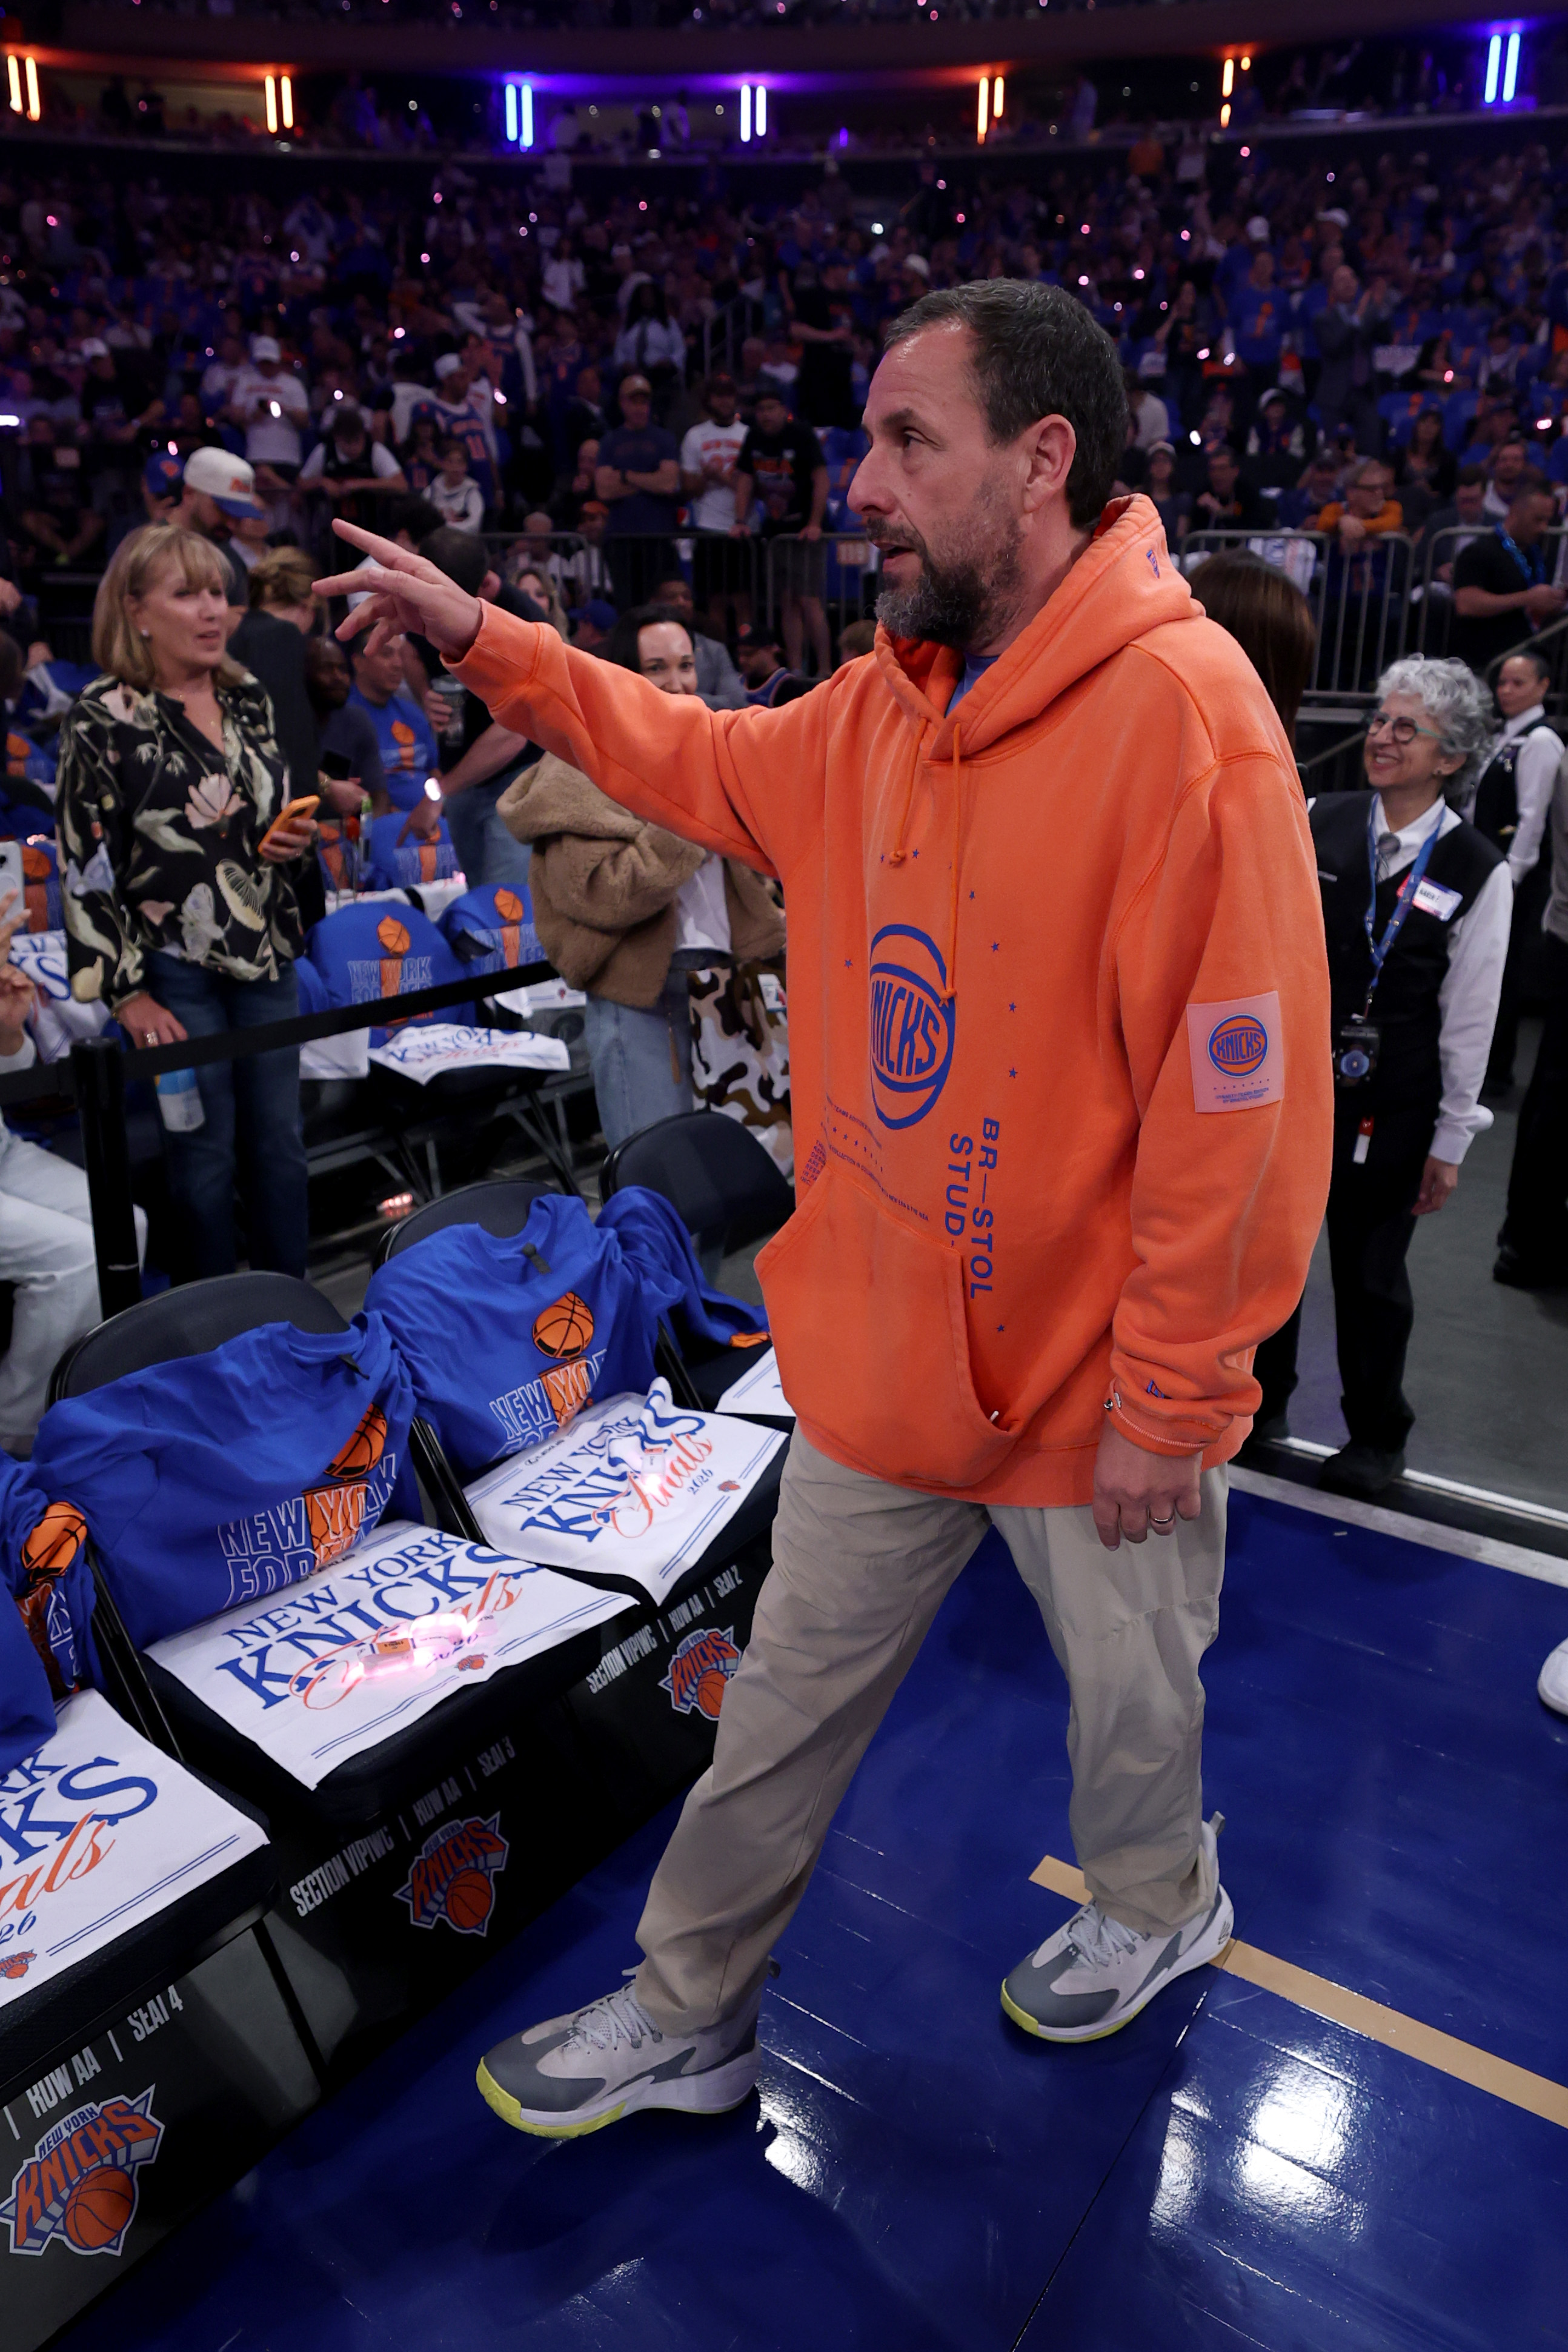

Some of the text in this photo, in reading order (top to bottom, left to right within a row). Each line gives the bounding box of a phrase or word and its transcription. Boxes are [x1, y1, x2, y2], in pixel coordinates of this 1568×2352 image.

[872, 980, 940, 1076] NICKS
[1216, 1032, 1262, 1060] KNICKS
[489, 1378, 552, 1440] NEW
[217, 1496, 305, 1558] NEW
[500, 1461, 582, 1511] NEW
[686, 1467, 714, 1495] 2026
[216, 1543, 542, 1710] KNICKS
[221, 1584, 340, 1649] NEW
[342, 1532, 471, 1589] YORK
[585, 1646, 628, 1695] SECTION
[688, 1593, 705, 1618] AA
[731, 1564, 744, 1586] 2
[671, 1631, 739, 1706] KNICKS
[289, 1853, 351, 1918] SECTION
[440, 1776, 463, 1806] AA
[502, 1735, 517, 1759] 3
[412, 1821, 506, 1921] KNICKS
[70, 2045, 102, 2087] AA
[167, 1983, 184, 2011] 4
[16, 2098, 159, 2247] KNICKS
[38, 2102, 99, 2161] NEW YORK
